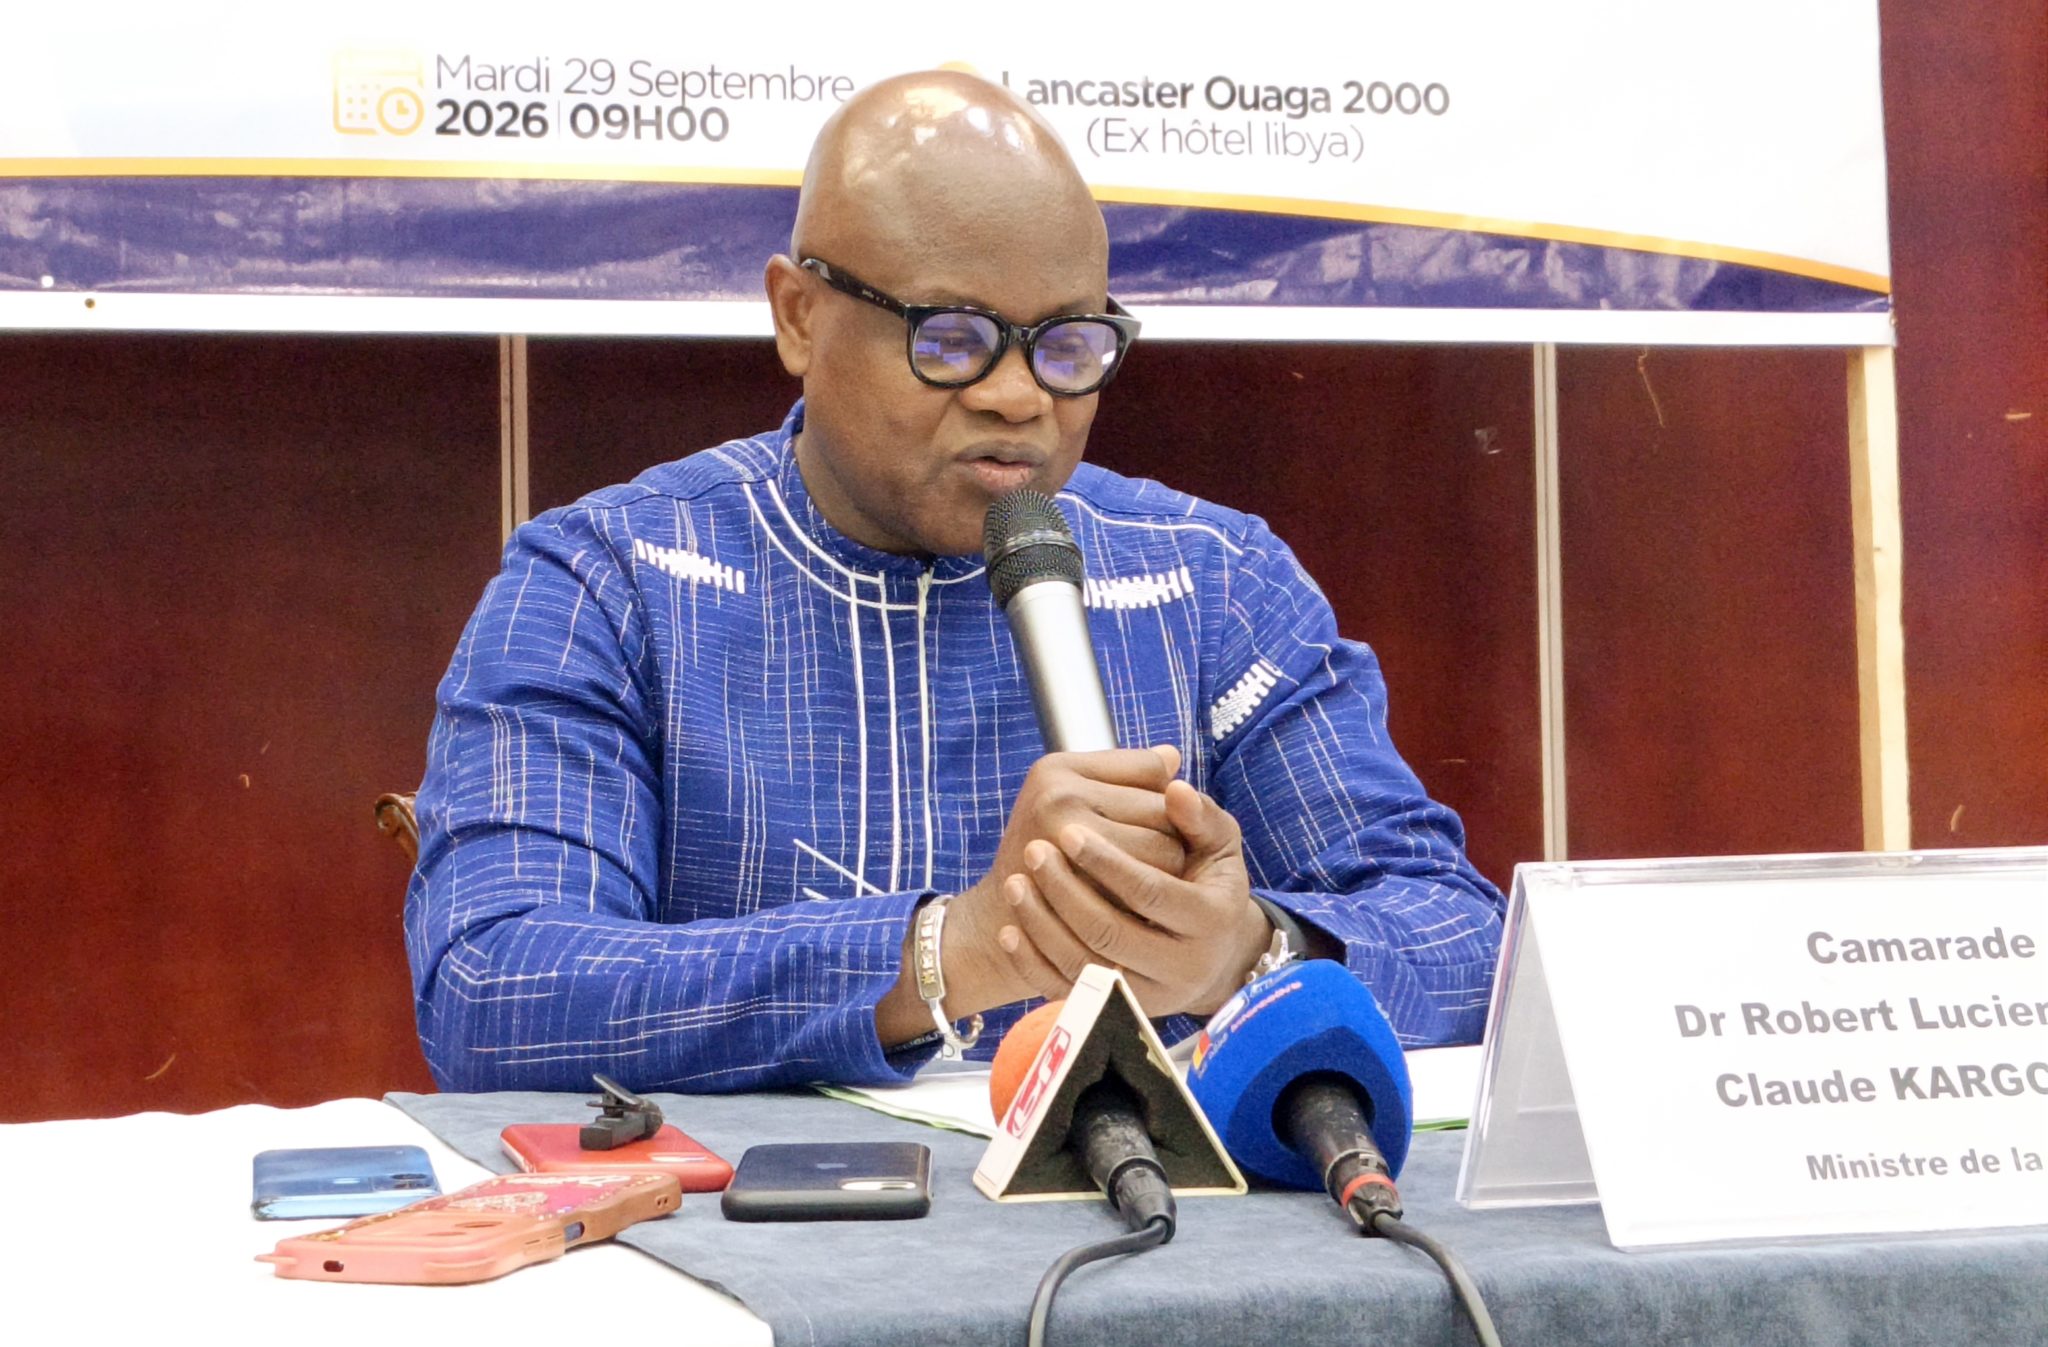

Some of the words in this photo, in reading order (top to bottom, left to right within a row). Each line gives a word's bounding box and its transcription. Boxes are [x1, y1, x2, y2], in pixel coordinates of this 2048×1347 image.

[437, 55, 549, 93] Mardi
[564, 58, 615, 96] 29
[629, 60, 855, 106] Septembre
[1204, 75, 1331, 119] Ouaga
[1343, 80, 1450, 116] 2000
[435, 99, 549, 138] 2026
[569, 105, 729, 142] 09H00
[1087, 117, 1148, 157] (Ex
[1162, 119, 1252, 156] hôtel
[1264, 122, 1365, 163] libya)
[1807, 927, 2035, 964] Camarade
[1675, 1005, 1726, 1037] Dr
[1741, 999, 1898, 1036] Robert
[1716, 1070, 1876, 1107] Claude
[1806, 1153, 1948, 1180] Ministre
[1960, 1149, 2001, 1174] de
[2011, 1147, 2043, 1172] la
